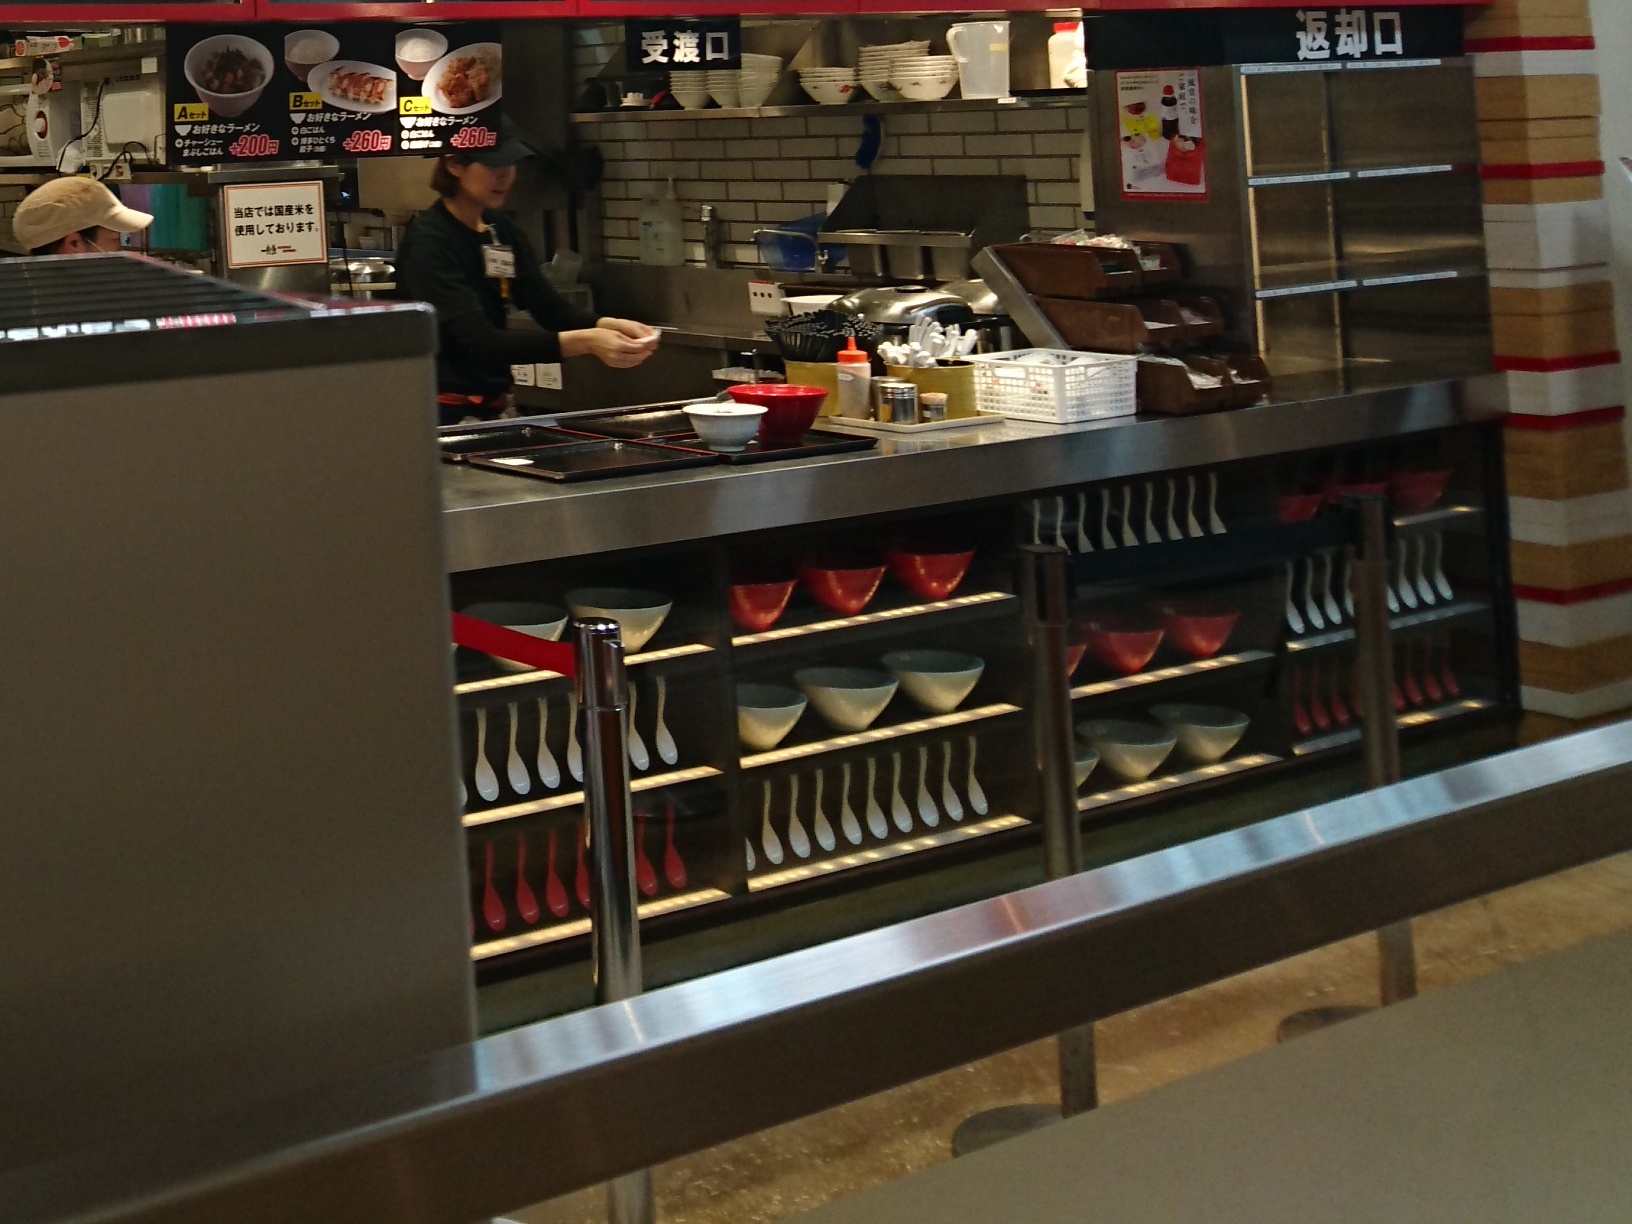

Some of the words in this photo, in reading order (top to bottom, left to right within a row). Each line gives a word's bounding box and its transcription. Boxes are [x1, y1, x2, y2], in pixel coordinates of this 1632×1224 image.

[640, 29, 730, 64] 受渡口
[1295, 9, 1404, 62] 返却口
[306, 111, 372, 123] お好きなラーメン
[191, 123, 261, 135] お好きなラーメン
[450, 126, 497, 148] +260円
[229, 133, 280, 157] +200円
[342, 129, 392, 152] +260円
[233, 203, 315, 219] 当店では国産米を
[234, 221, 319, 237] 使用しております。
